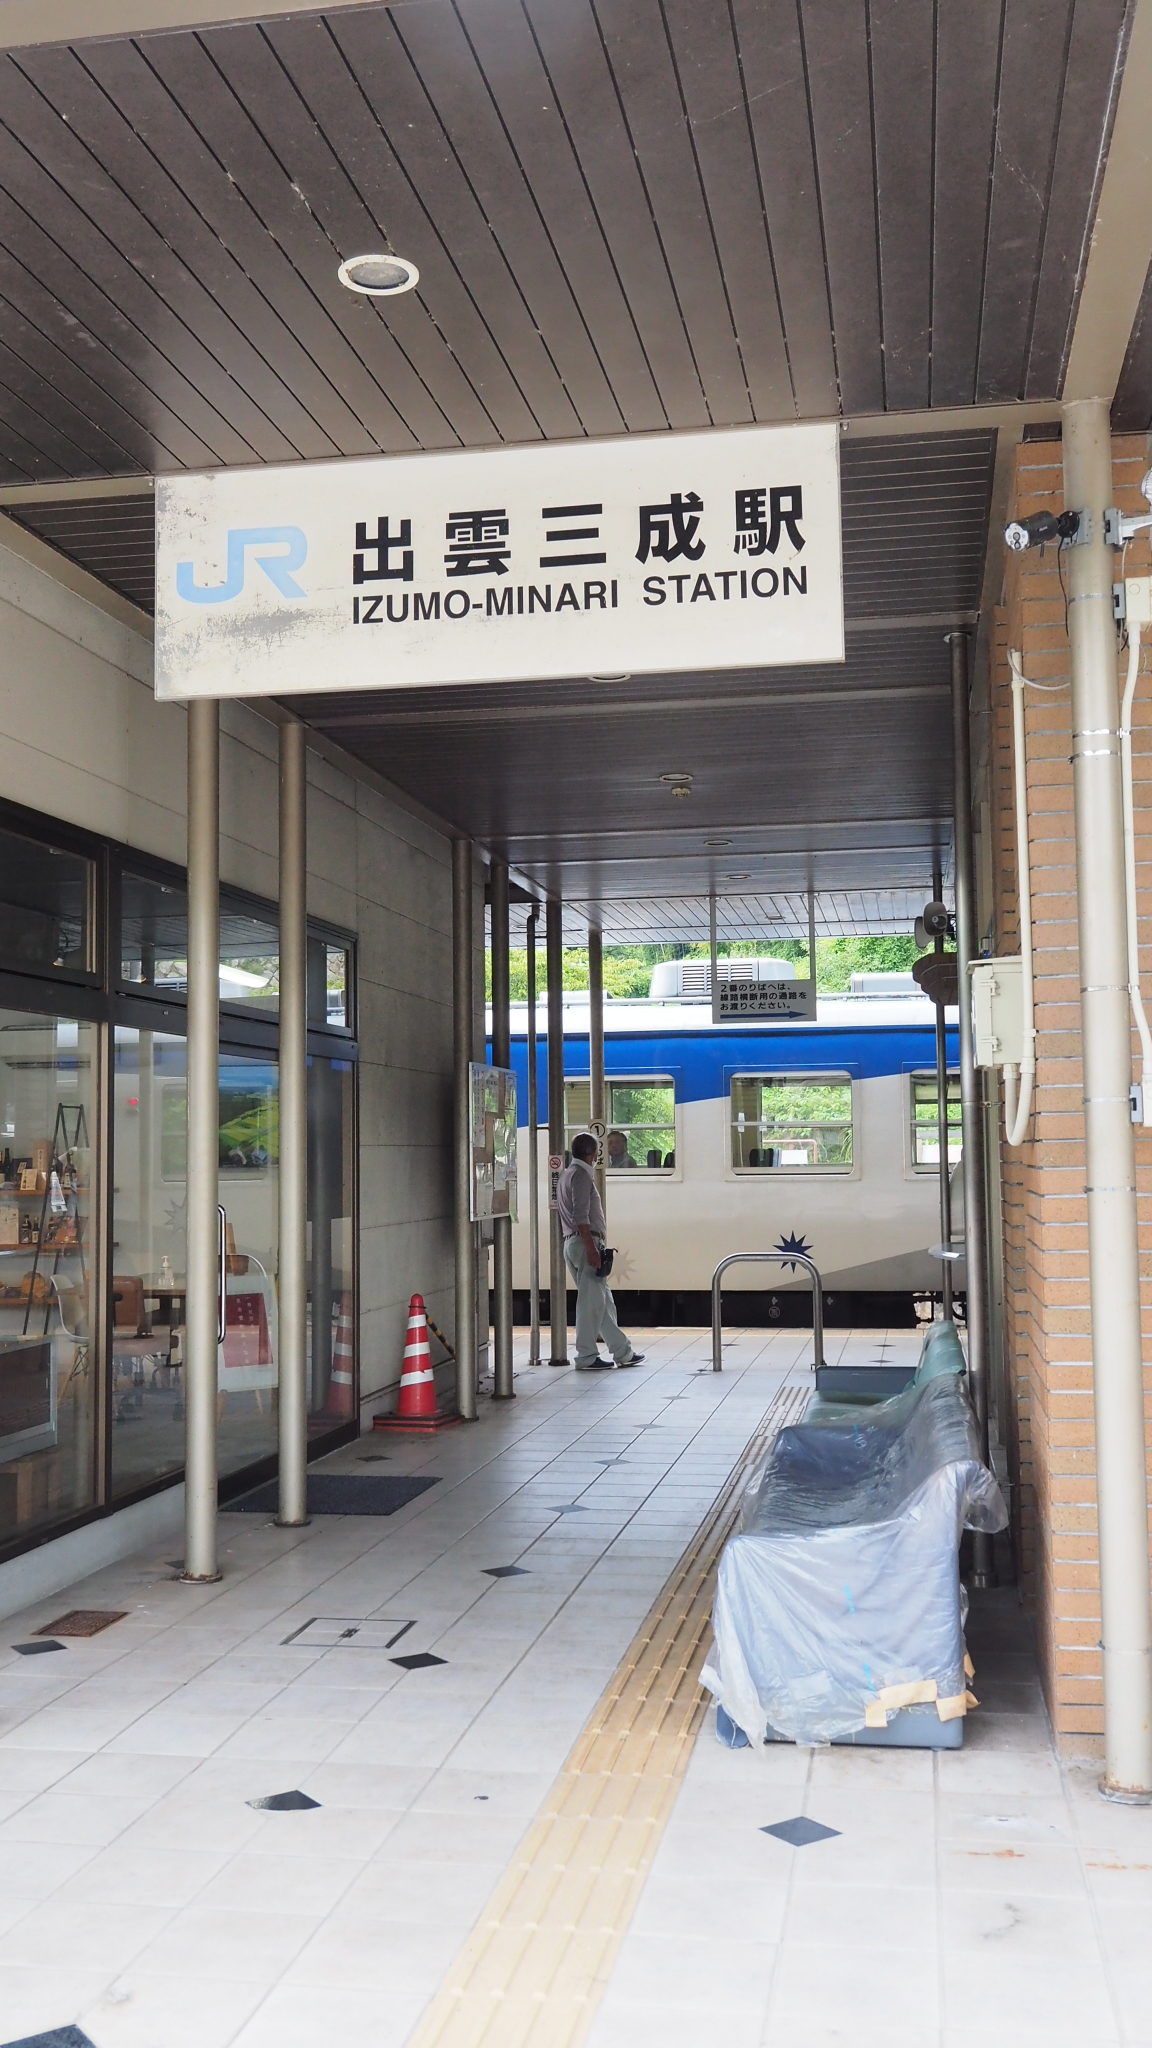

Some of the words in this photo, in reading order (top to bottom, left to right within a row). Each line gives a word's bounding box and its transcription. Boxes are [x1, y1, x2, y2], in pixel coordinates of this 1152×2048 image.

[176, 525, 308, 604] JR
[352, 485, 806, 585] 出雲三成駅
[353, 579, 618, 625] IZUMO-MINARI
[643, 565, 808, 607] STATION
